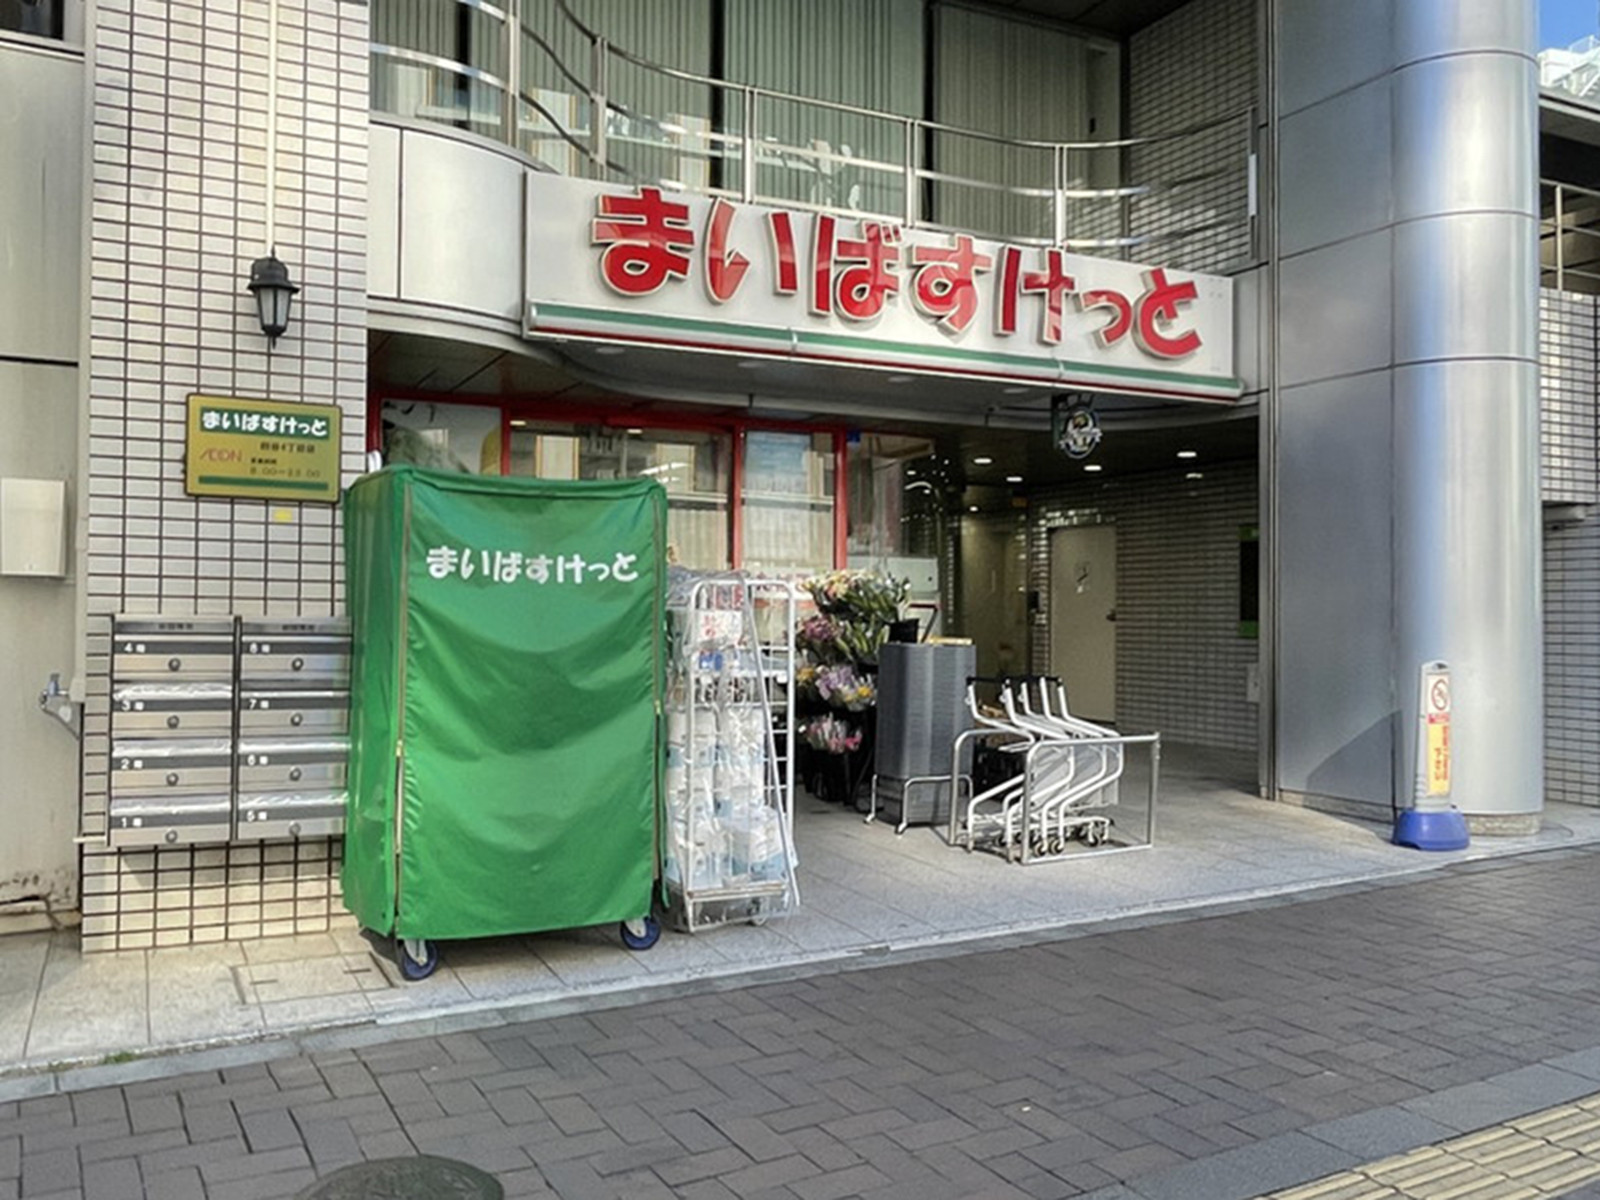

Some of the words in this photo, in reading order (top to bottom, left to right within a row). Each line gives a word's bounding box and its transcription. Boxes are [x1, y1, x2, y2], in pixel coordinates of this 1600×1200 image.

[591, 187, 1203, 360] まいばすけっと
[202, 411, 327, 437] まいばすけっと
[426, 545, 639, 584] まいばすけっと
